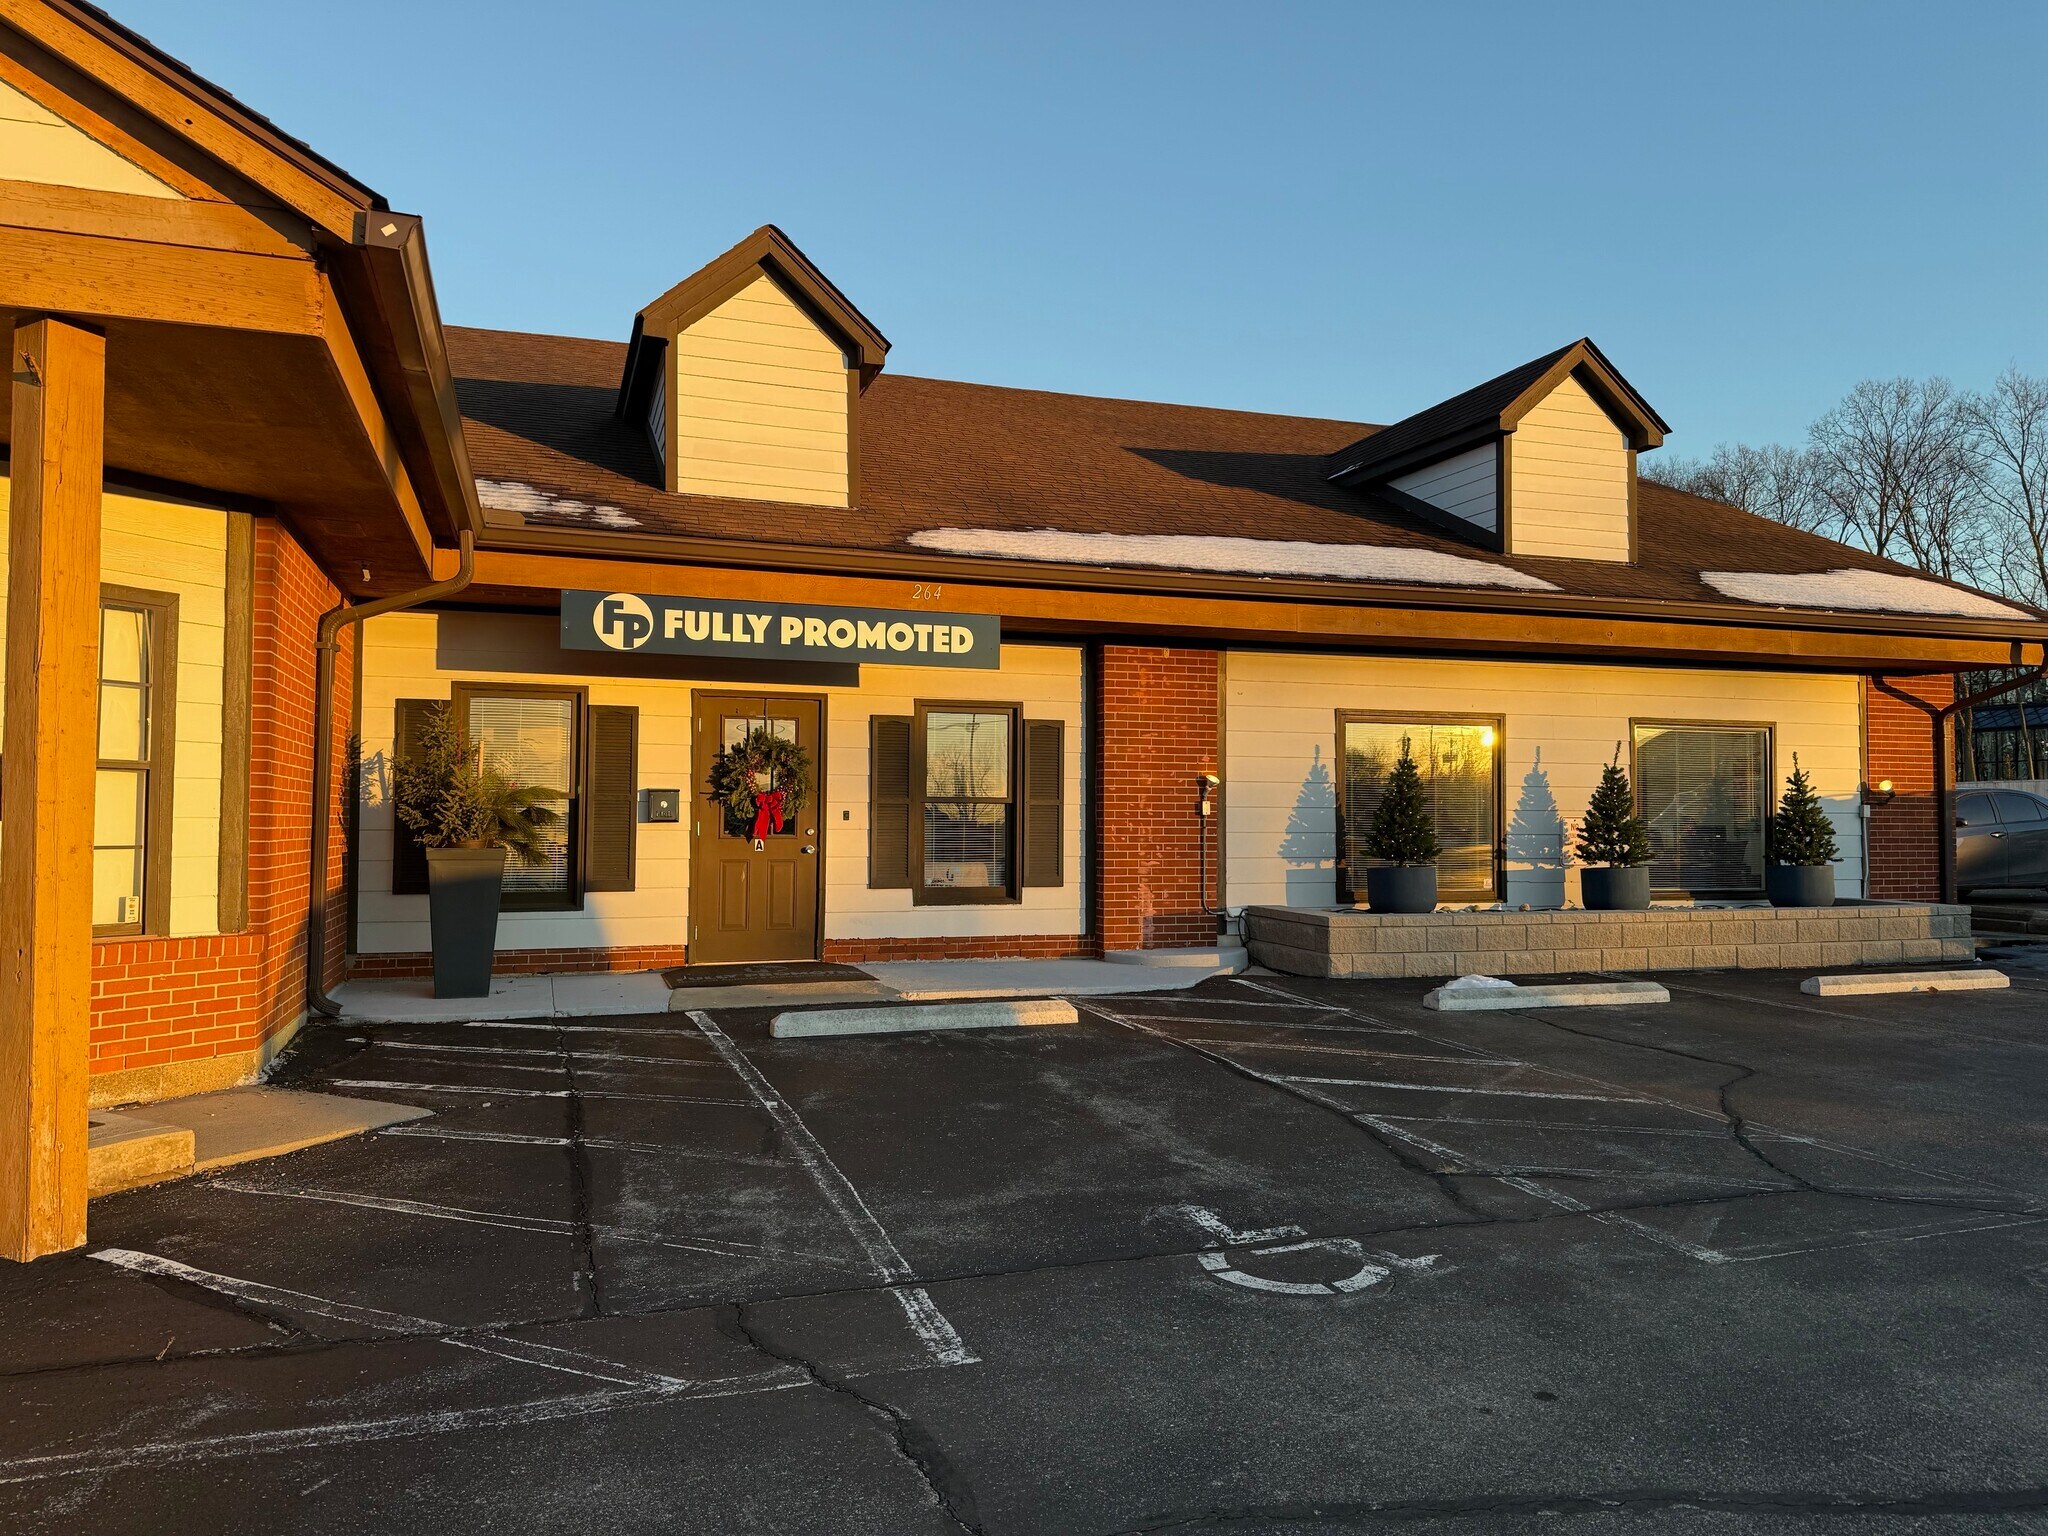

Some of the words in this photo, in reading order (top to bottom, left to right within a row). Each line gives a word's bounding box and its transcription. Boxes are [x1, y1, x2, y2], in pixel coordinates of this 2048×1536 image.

[912, 584, 942, 600] 264
[664, 608, 773, 644] FULLY
[780, 616, 974, 654] PROMOTED
[756, 840, 763, 850] A
